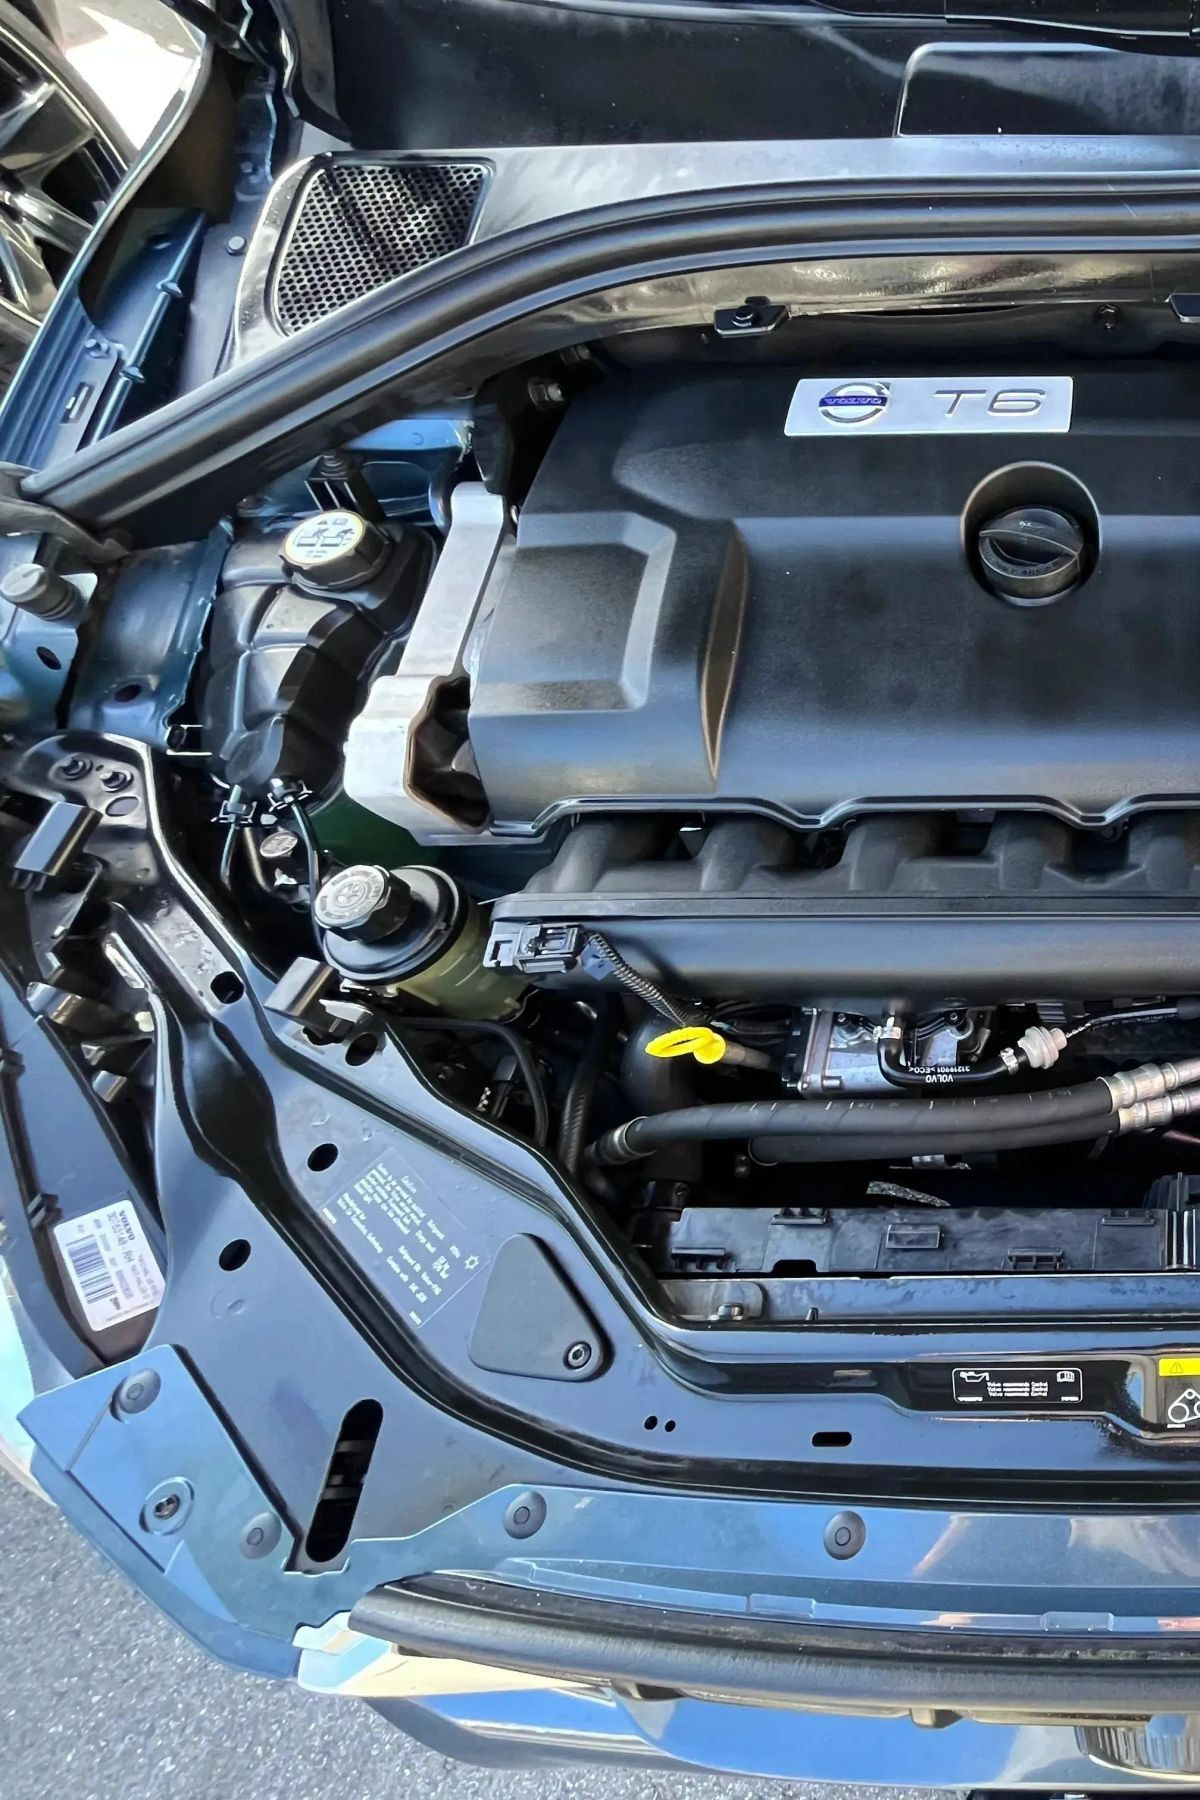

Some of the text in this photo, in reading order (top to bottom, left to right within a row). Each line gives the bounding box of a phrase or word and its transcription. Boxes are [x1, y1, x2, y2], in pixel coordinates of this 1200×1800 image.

[823, 397, 882, 405] VOLVO
[934, 389, 1046, 414] T6
[925, 1073, 954, 1083] VOLVO
[118, 1209, 136, 1241] VOLVO
